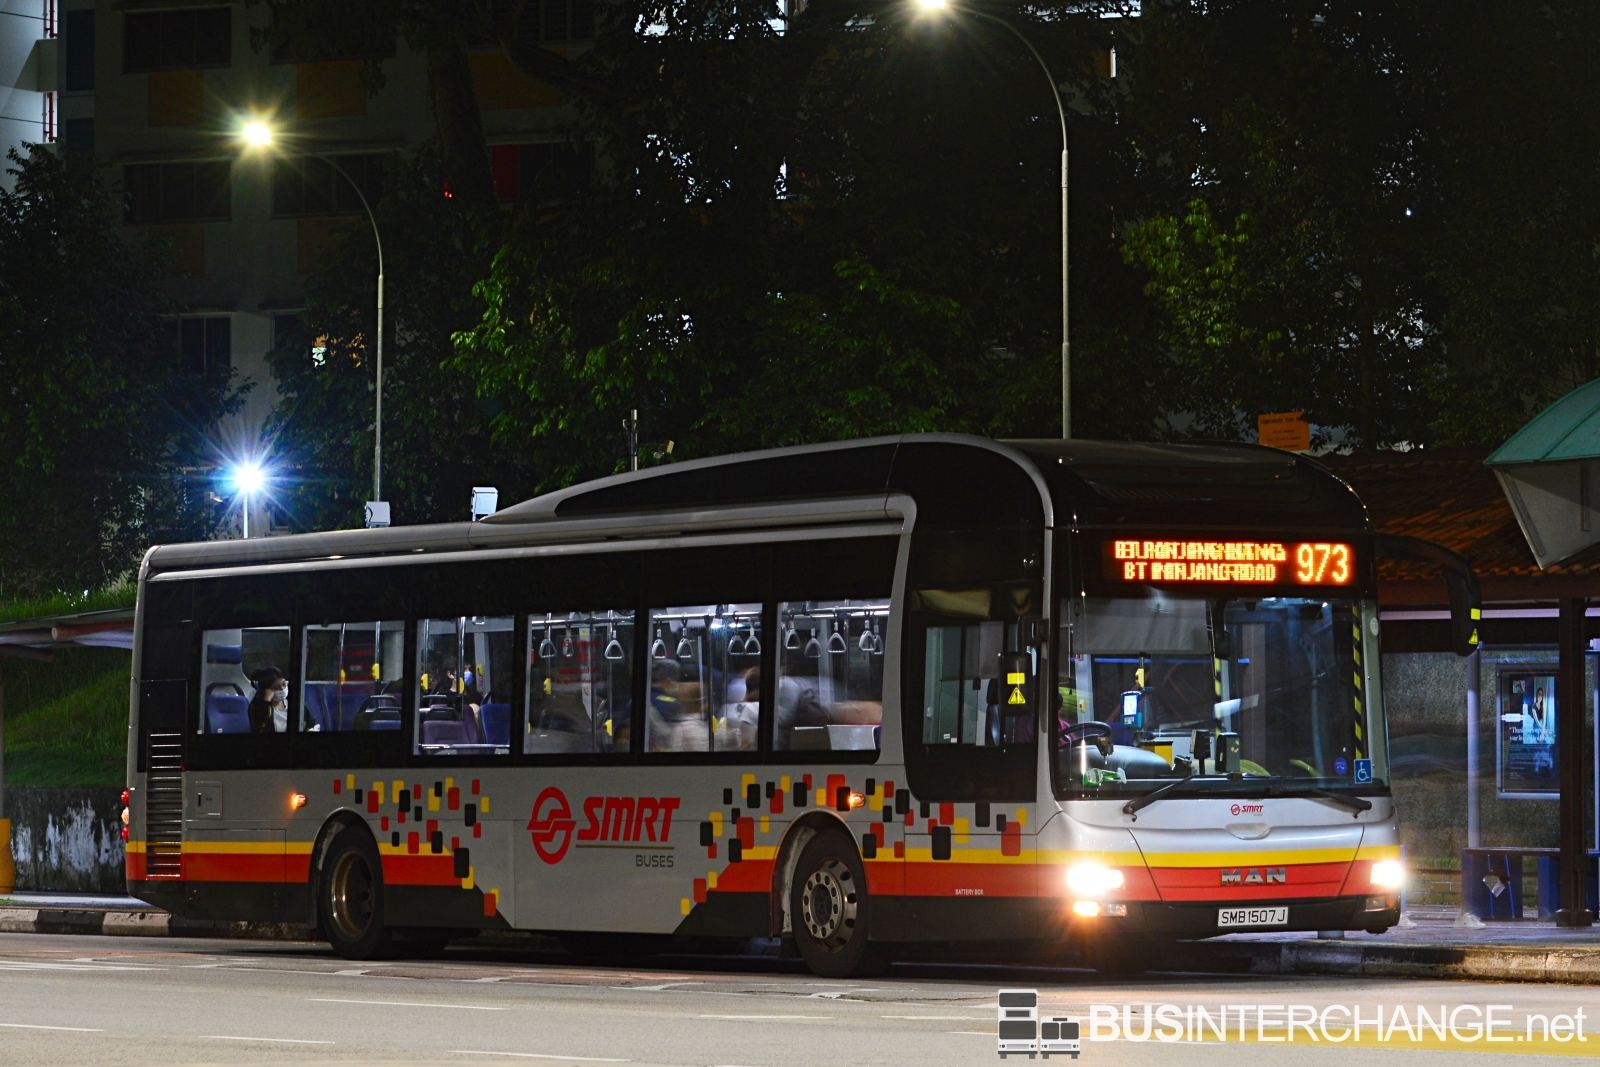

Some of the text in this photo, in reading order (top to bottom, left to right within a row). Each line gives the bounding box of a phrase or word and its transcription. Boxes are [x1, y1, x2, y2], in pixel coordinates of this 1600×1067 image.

[1125, 562, 1147, 579] BT
[1298, 544, 1348, 582] 973
[1241, 805, 1264, 813] SMRT
[577, 797, 681, 842] SMRT
[636, 855, 674, 868] BUSES
[1221, 868, 1286, 885] MAN
[1221, 909, 1286, 924] SMB1507J
